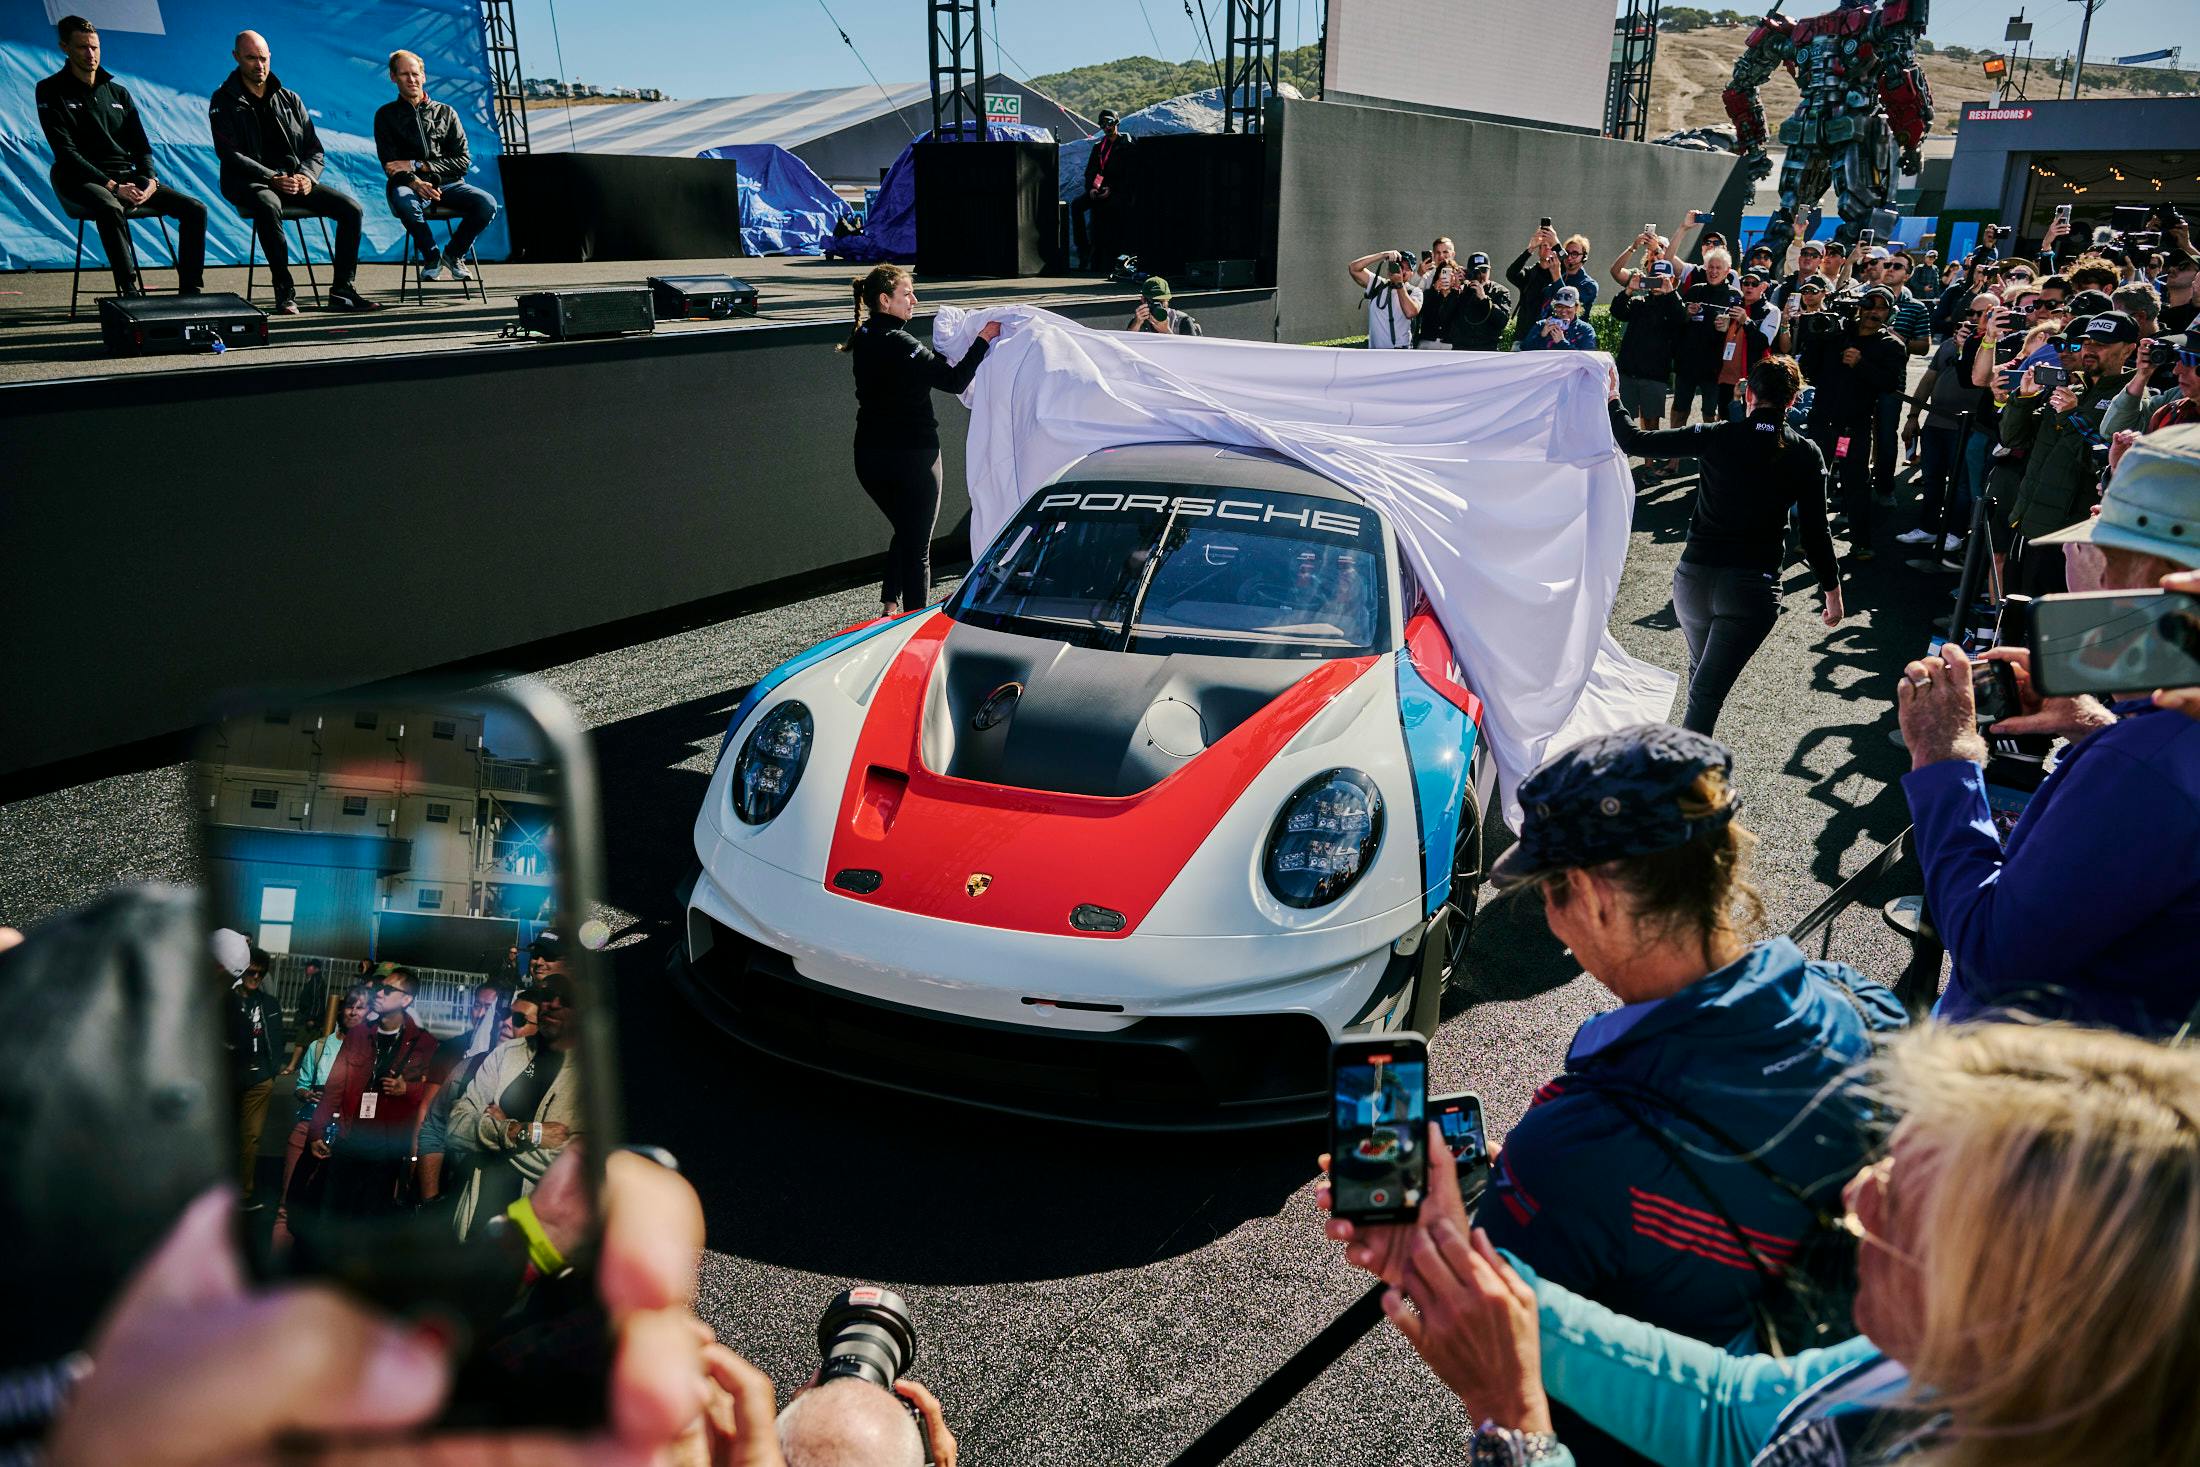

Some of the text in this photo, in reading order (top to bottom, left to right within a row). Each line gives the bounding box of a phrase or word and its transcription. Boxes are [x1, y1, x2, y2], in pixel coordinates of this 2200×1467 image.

[984, 96, 1017, 113] TAG
[1968, 109, 2025, 120] RESTROOMS
[2088, 321, 2113, 330] PING
[1037, 493, 1361, 537] PORSCHE
